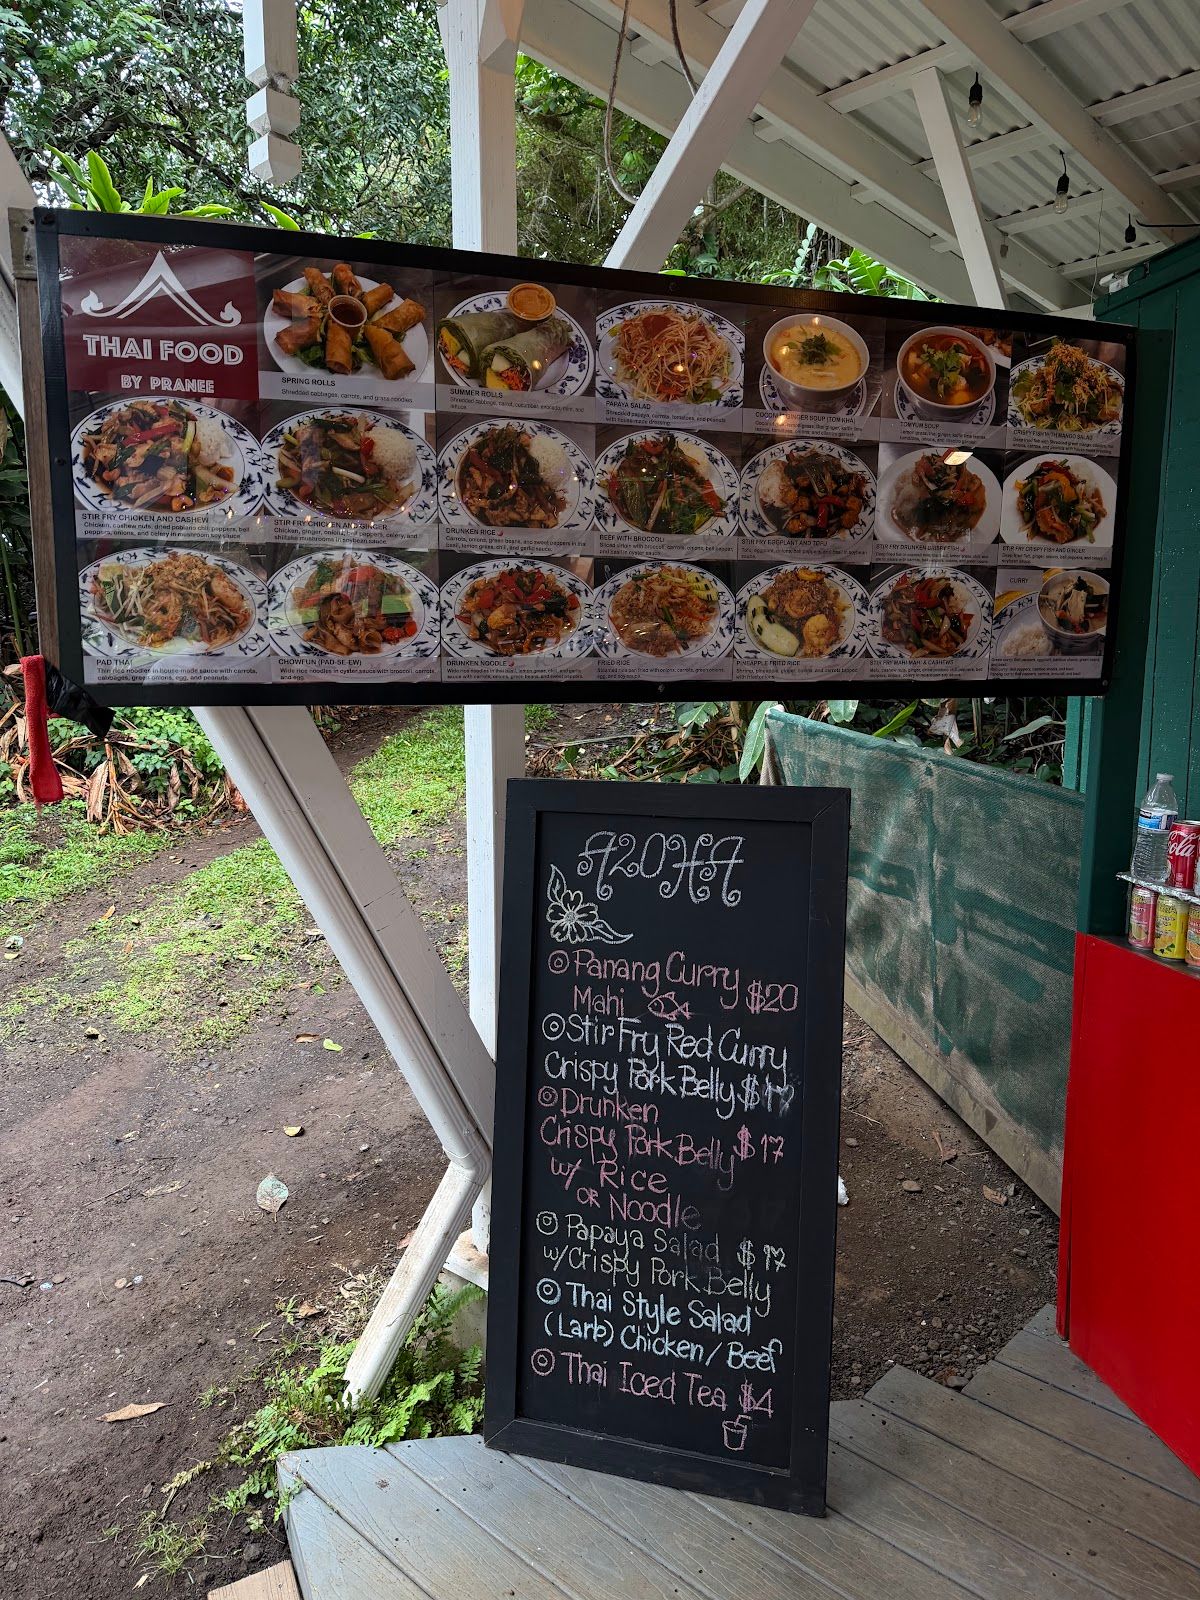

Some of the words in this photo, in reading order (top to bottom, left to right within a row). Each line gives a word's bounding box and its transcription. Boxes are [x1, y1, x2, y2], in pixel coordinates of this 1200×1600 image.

[83, 334, 152, 359] THAI
[160, 340, 243, 365] FOOD
[121, 375, 142, 389] BY
[150, 376, 215, 393] PRANEE
[281, 377, 310, 385] SPRING
[311, 379, 336, 387] ROLLS
[450, 388, 480, 397] SUMMER
[630, 402, 651, 410] SALAD
[81, 513, 100, 521] STIR
[157, 515, 174, 523] AND
[175, 516, 209, 524] CASHEW
[274, 519, 292, 527] STIR
[318, 658, 362, 666] (PAD-SE-EW)
[577, 831, 745, 907] ALOHA
[573, 948, 660, 998] Panang
[666, 951, 740, 1010] Curry
[746, 980, 799, 1014] $20
[574, 985, 625, 1017] Mahi
[566, 1013, 614, 1045] Stir
[618, 1017, 660, 1071] Fry
[665, 1022, 713, 1062] Red
[718, 1028, 787, 1086] Curry
[545, 1051, 618, 1095] Crispy
[628, 1057, 676, 1096] Pork
[678, 1065, 735, 1120] Belly
[560, 1087, 659, 1123] Drunken
[540, 1115, 618, 1165] Crispy
[624, 1124, 674, 1158] Pork
[674, 1133, 735, 1191] Belly
[551, 1157, 582, 1190] w/
[597, 1160, 668, 1193] Rice
[610, 1193, 701, 1230] Noodle
[565, 1213, 645, 1260] Papaya
[654, 1228, 719, 1264] Salad
[651, 1257, 700, 1293] Pork
[703, 1266, 771, 1317] Belly
[566, 1281, 612, 1312] Thai
[623, 1290, 681, 1335] Style
[688, 1300, 751, 1336] Salad
[544, 1311, 614, 1347] (Larb)
[726, 1338, 783, 1373] Beef
[561, 1351, 607, 1387] Thai
[618, 1361, 676, 1405] Iced
[682, 1371, 728, 1411] Tea
[739, 1378, 774, 1417] $4
